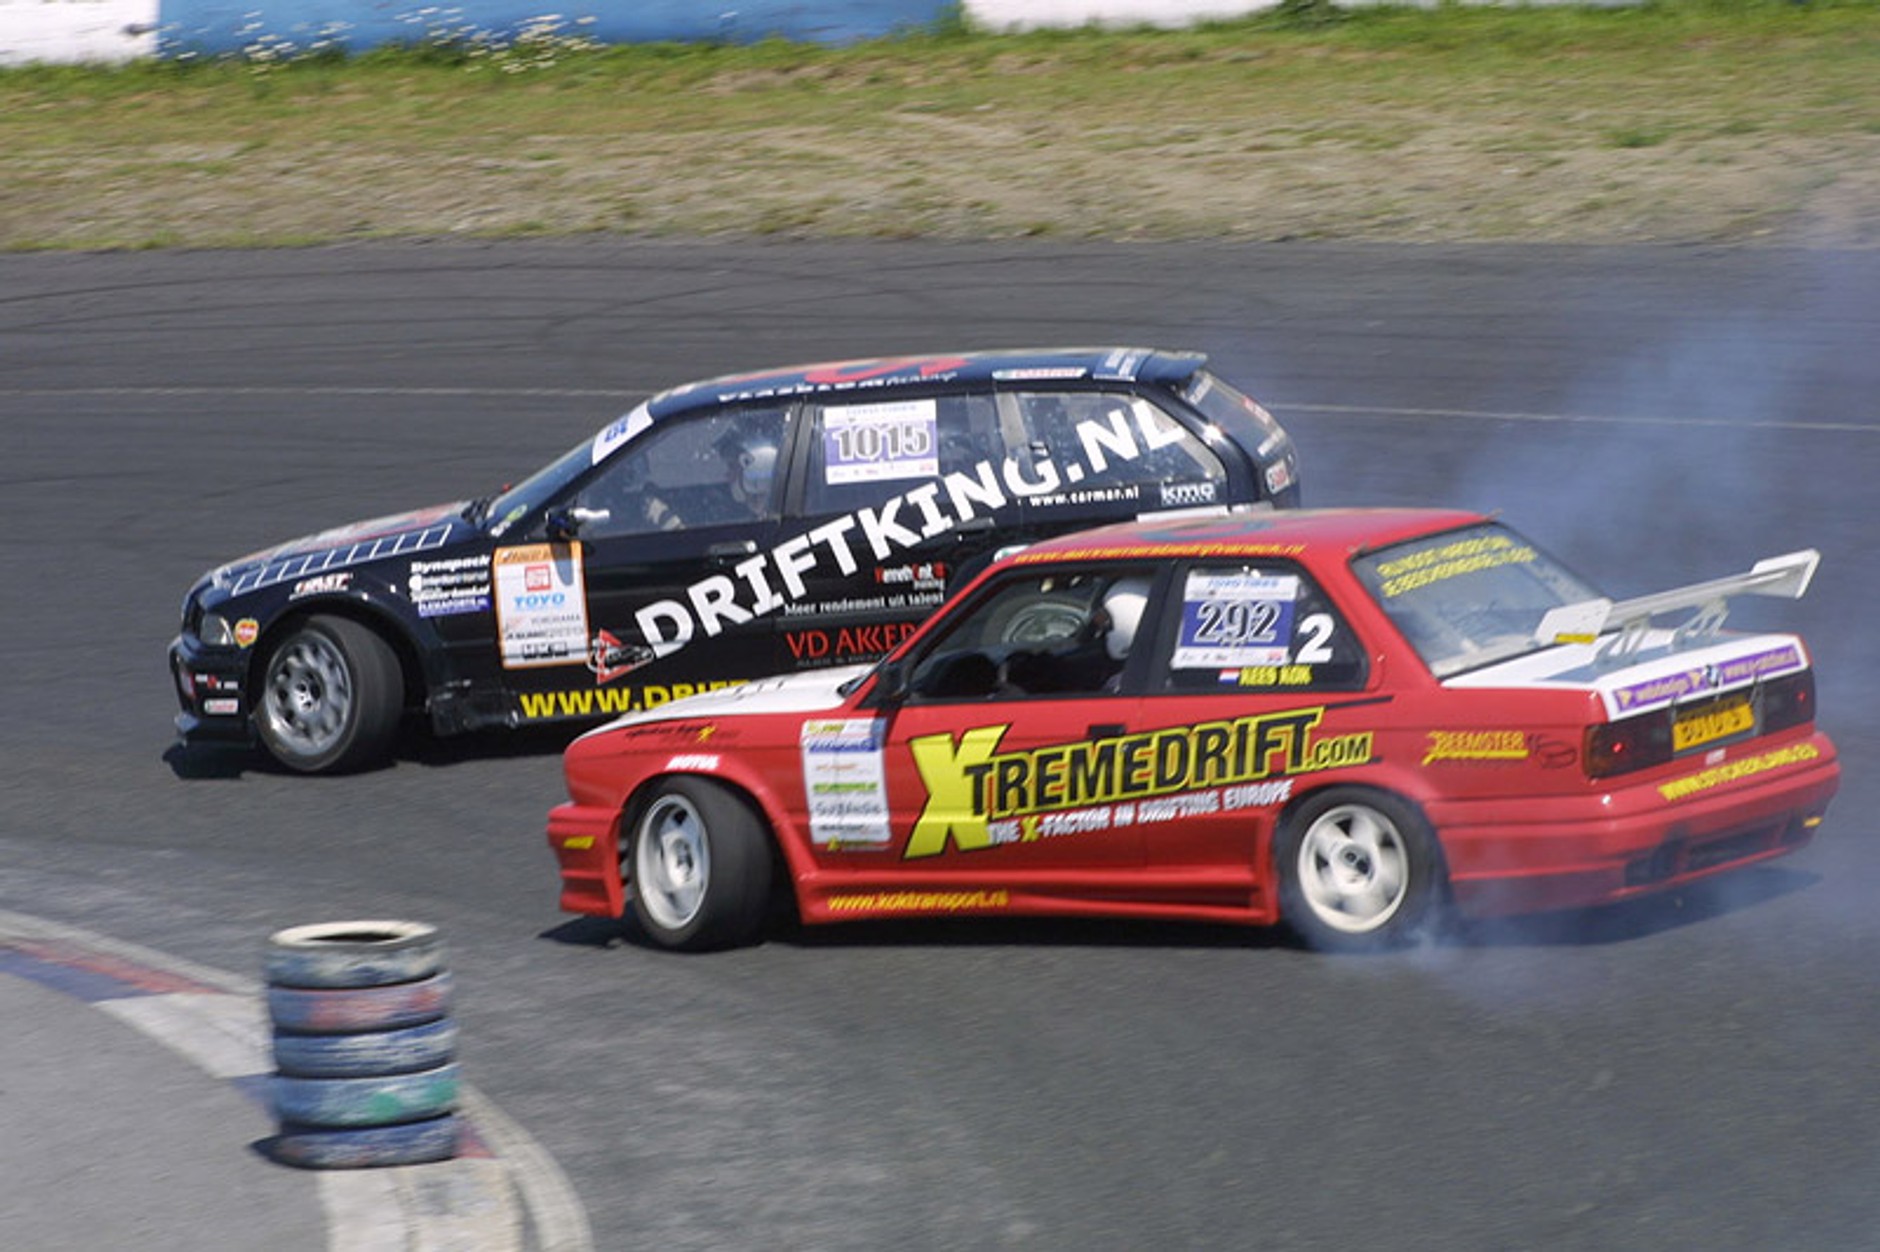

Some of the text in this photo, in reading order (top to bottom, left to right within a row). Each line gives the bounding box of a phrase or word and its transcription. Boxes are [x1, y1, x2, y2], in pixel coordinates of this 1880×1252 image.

[832, 423, 930, 461] 1015
[635, 400, 1186, 659] DRIFTKING.NL
[513, 592, 566, 609] TOYO
[1193, 600, 1282, 643] 292
[786, 629, 830, 659] VD
[1296, 613, 1335, 664] 2
[987, 780, 1295, 844] THE X-FACTOR IN DRIFTING EUROPE
